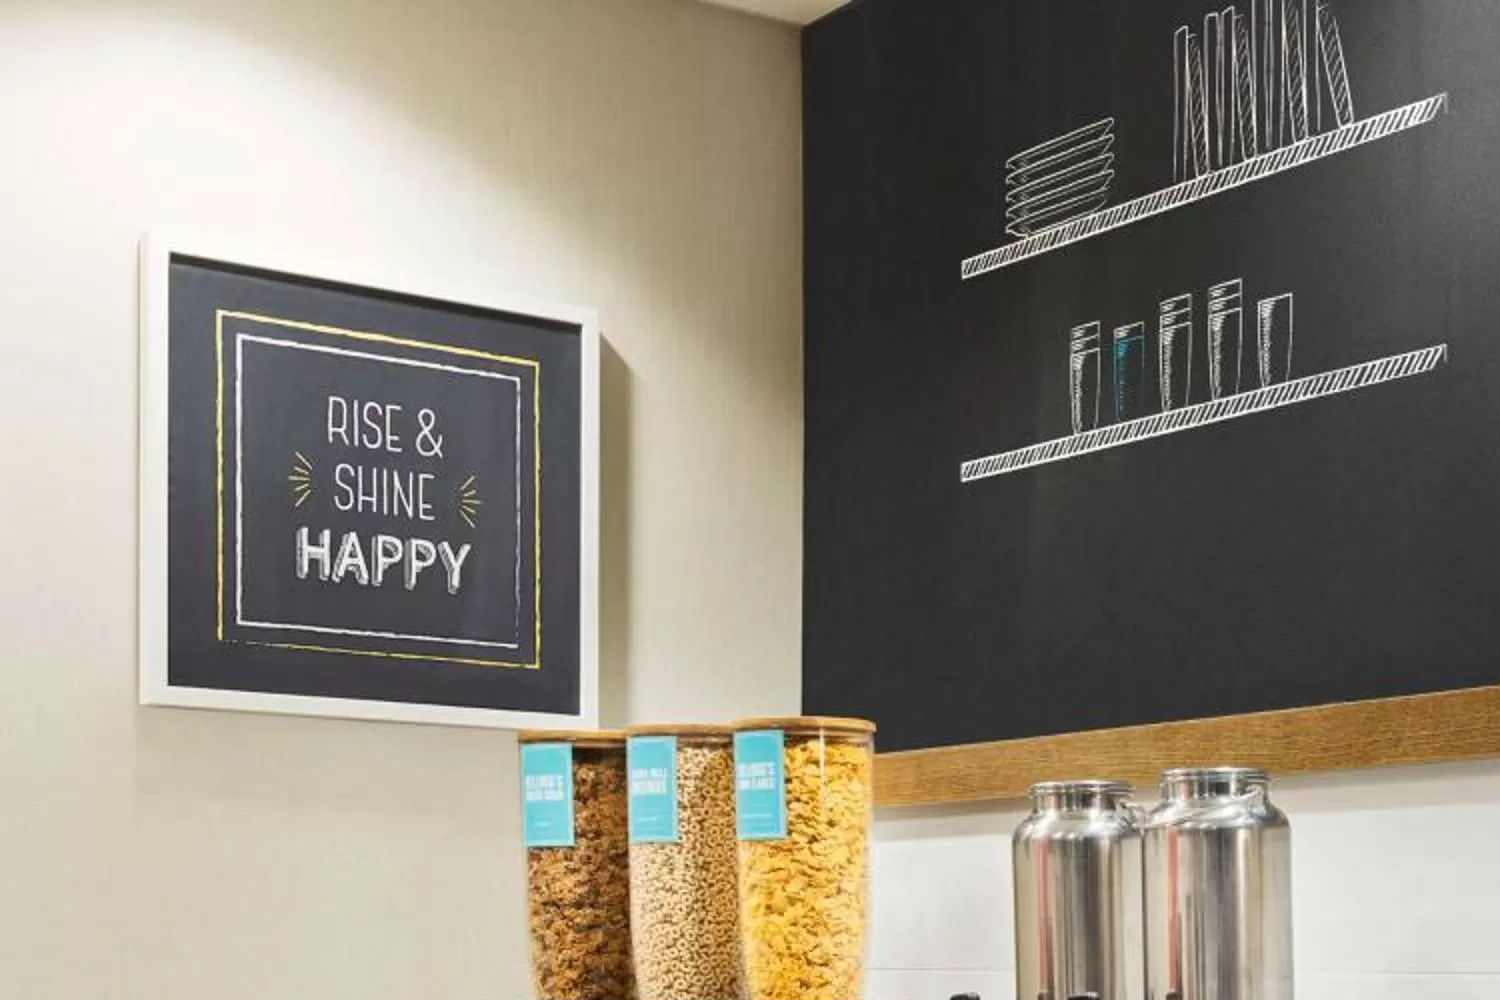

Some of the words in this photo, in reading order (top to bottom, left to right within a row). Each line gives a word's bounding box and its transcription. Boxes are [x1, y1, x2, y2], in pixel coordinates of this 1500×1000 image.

[327, 395, 403, 454] RISE
[415, 407, 444, 459] &
[333, 462, 436, 521] SHINE
[295, 526, 471, 594] HAPPY
